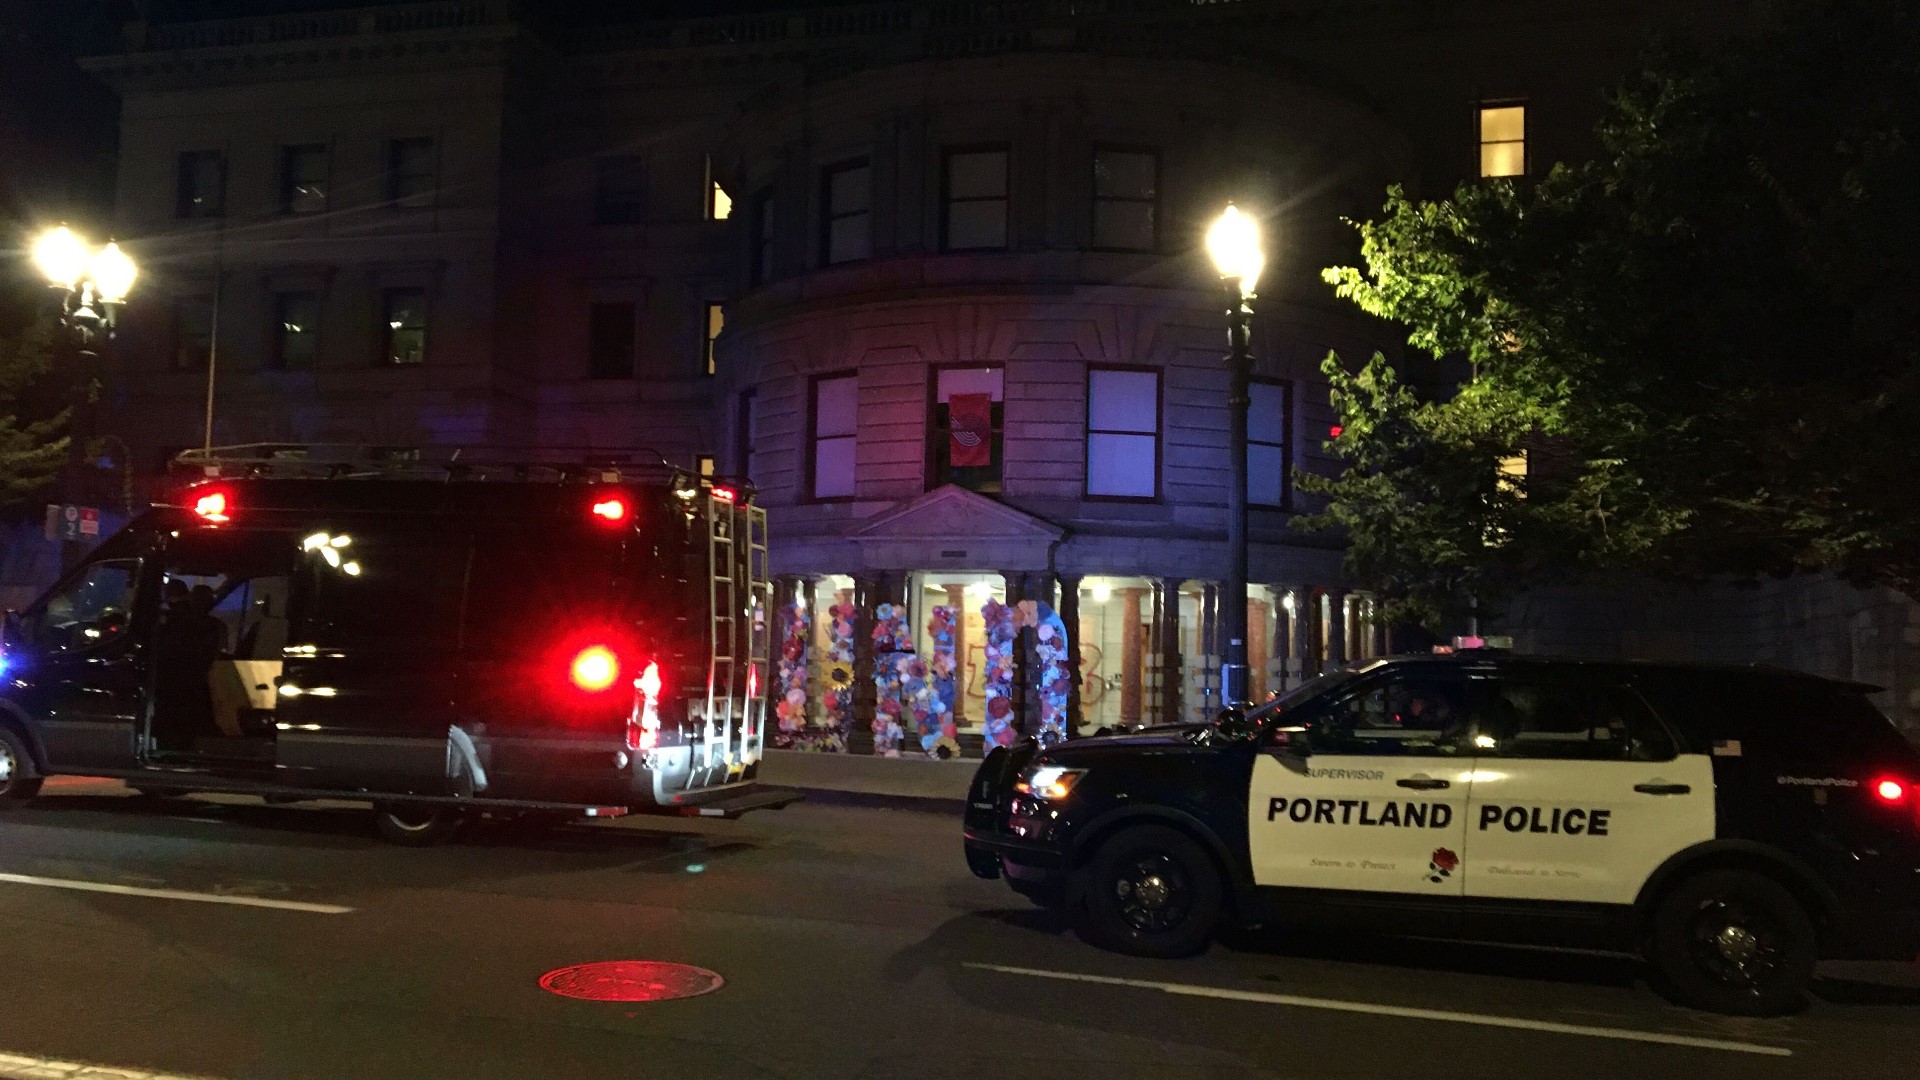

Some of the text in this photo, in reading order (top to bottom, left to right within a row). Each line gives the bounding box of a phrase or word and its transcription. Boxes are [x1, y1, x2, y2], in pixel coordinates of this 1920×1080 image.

[1303, 767, 1385, 780] SUPERVISOR
[1268, 797, 1611, 836] PORTLAND POLICE
